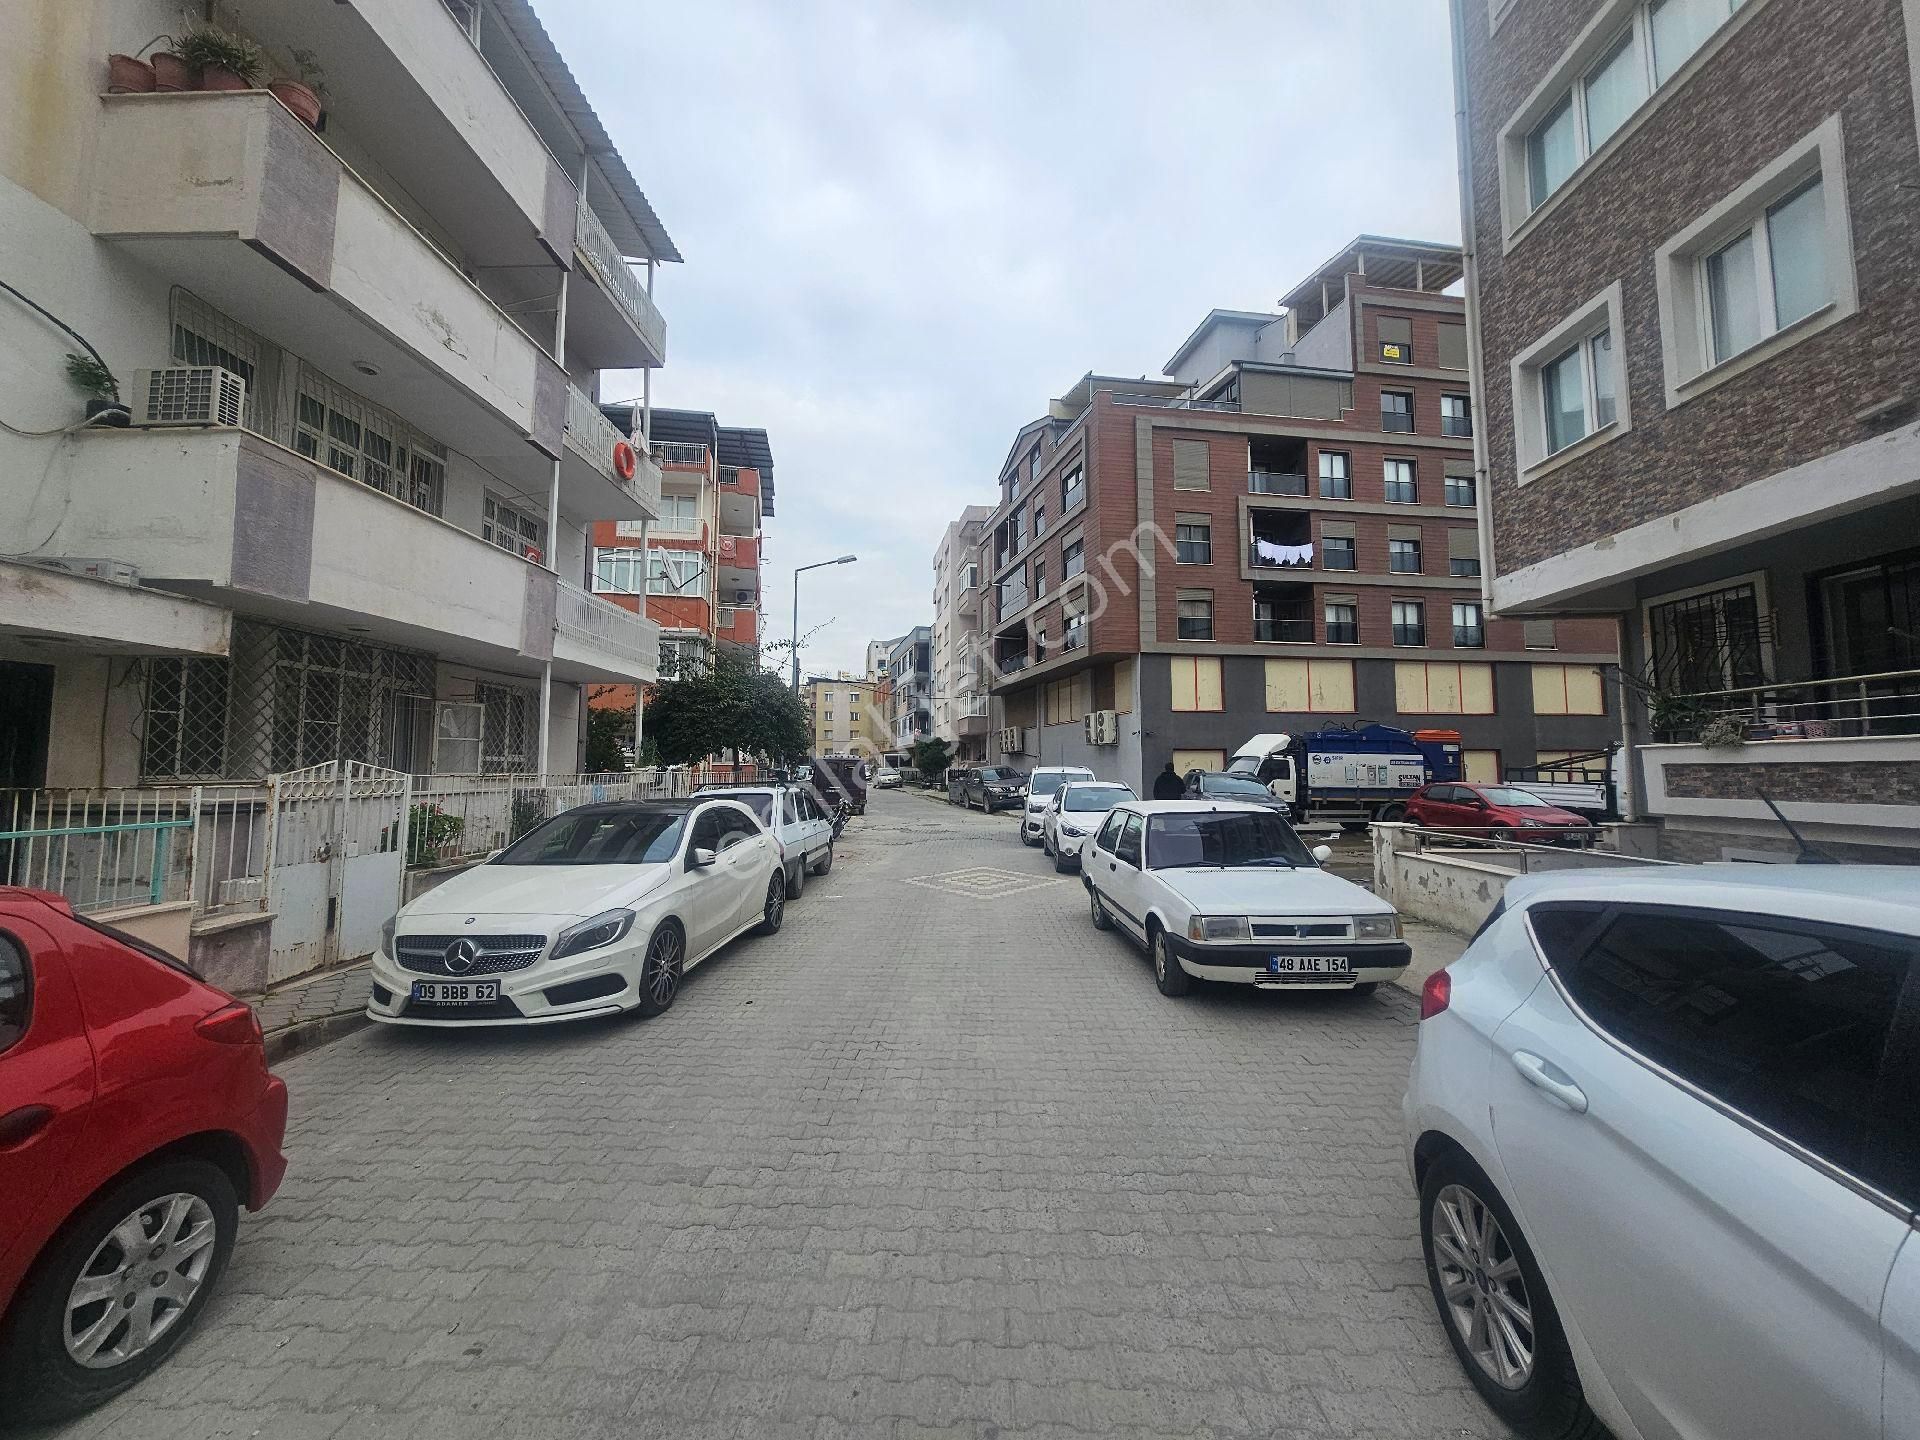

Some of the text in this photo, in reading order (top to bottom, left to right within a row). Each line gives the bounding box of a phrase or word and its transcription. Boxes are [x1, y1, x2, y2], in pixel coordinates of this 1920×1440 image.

[1279, 958, 1347, 972] 48 AAE 154
[420, 984, 435, 999] 09
[441, 985, 468, 999] BBB
[475, 984, 495, 999] 62
